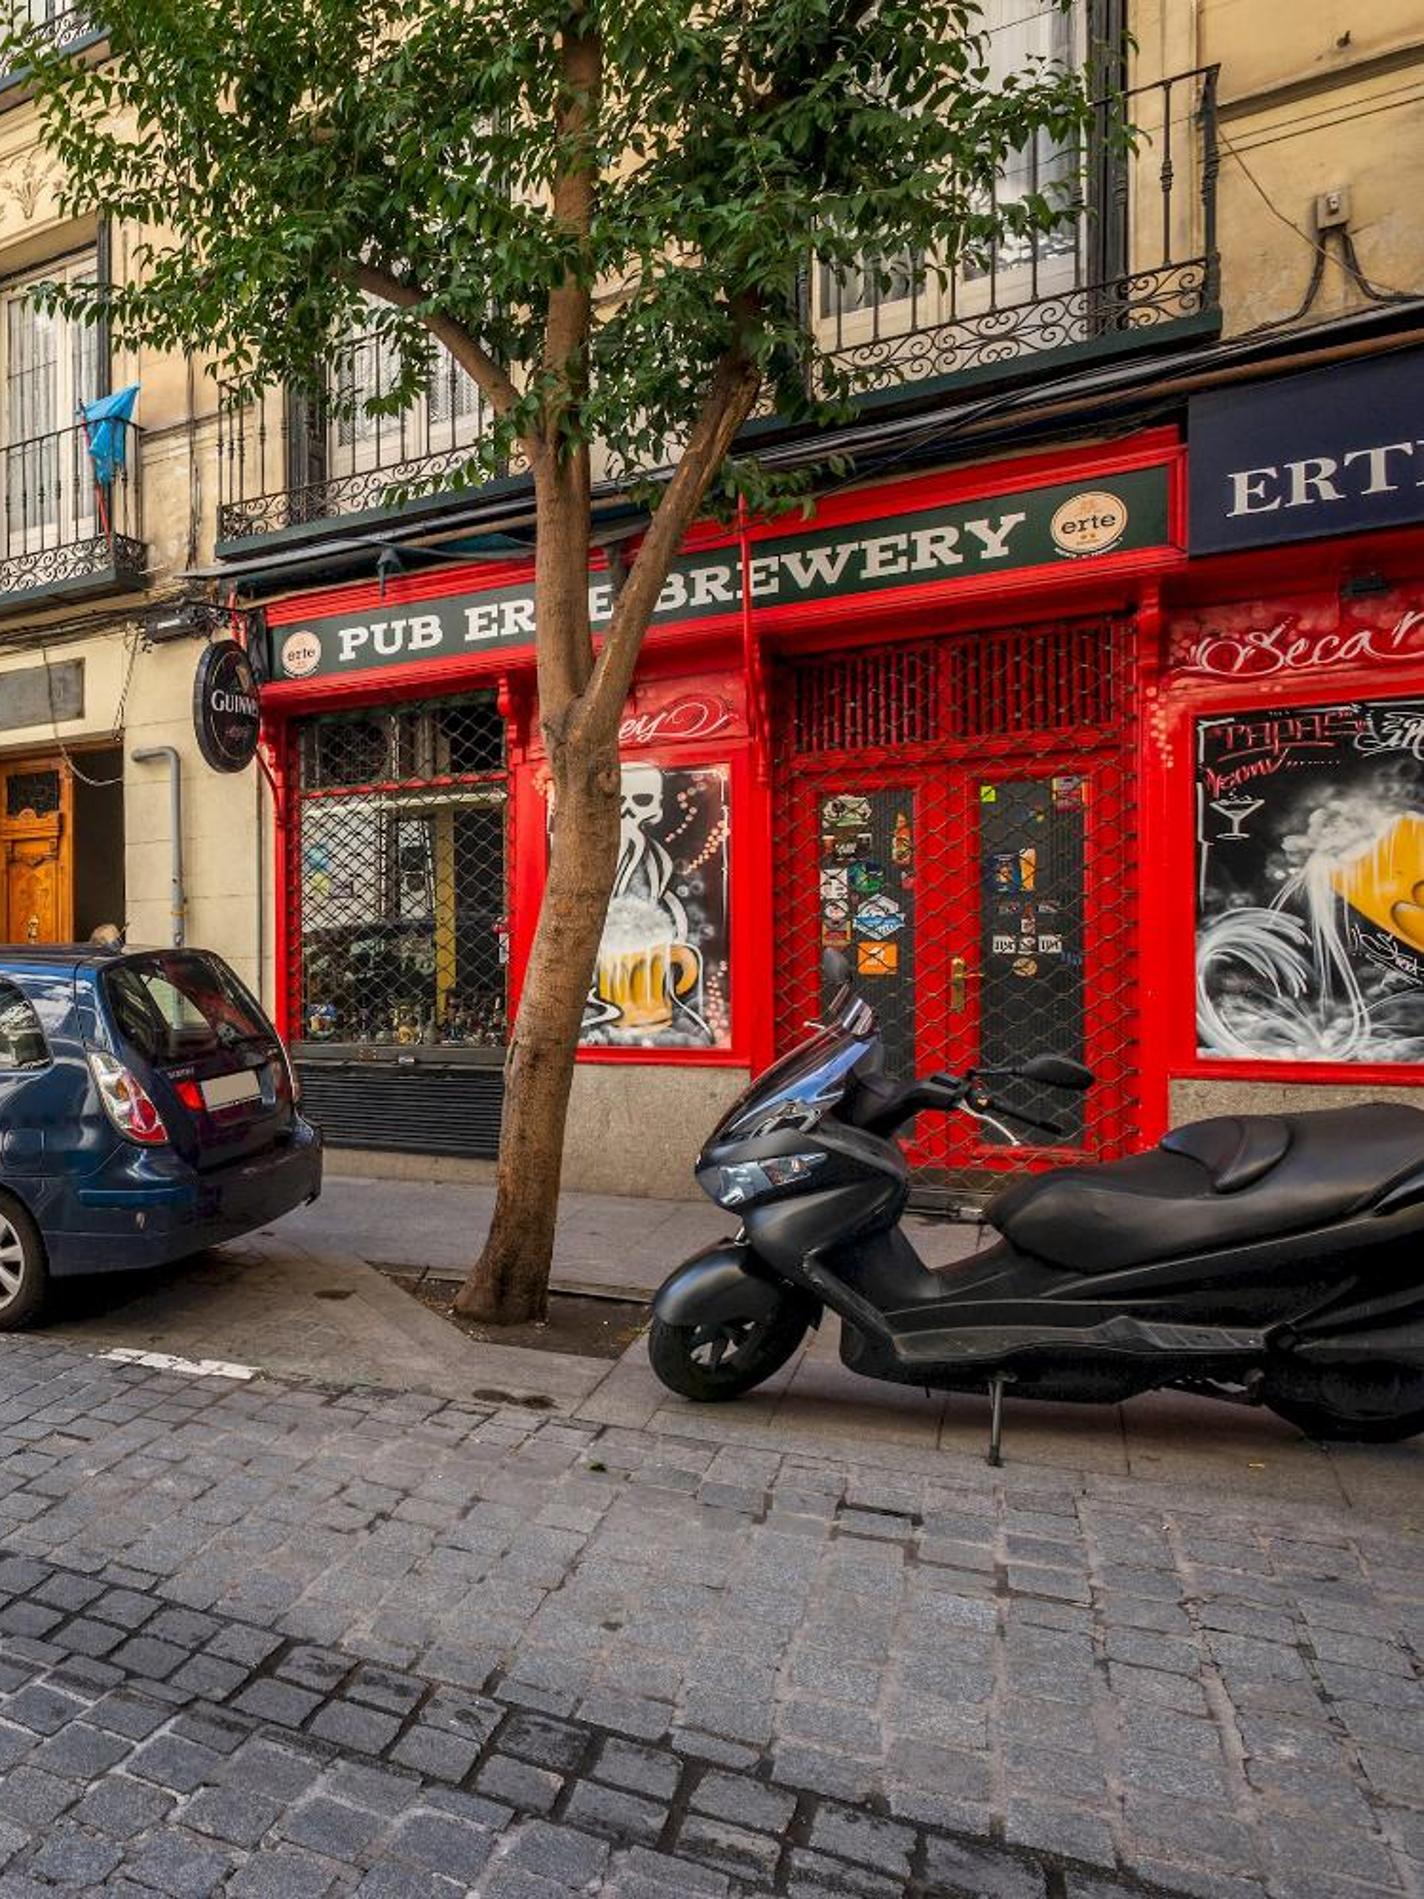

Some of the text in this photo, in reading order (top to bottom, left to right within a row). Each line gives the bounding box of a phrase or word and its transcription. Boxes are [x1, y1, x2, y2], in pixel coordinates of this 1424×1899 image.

[1061, 514, 1116, 535] erte
[338, 511, 1026, 662] PUB ERE BREWERY
